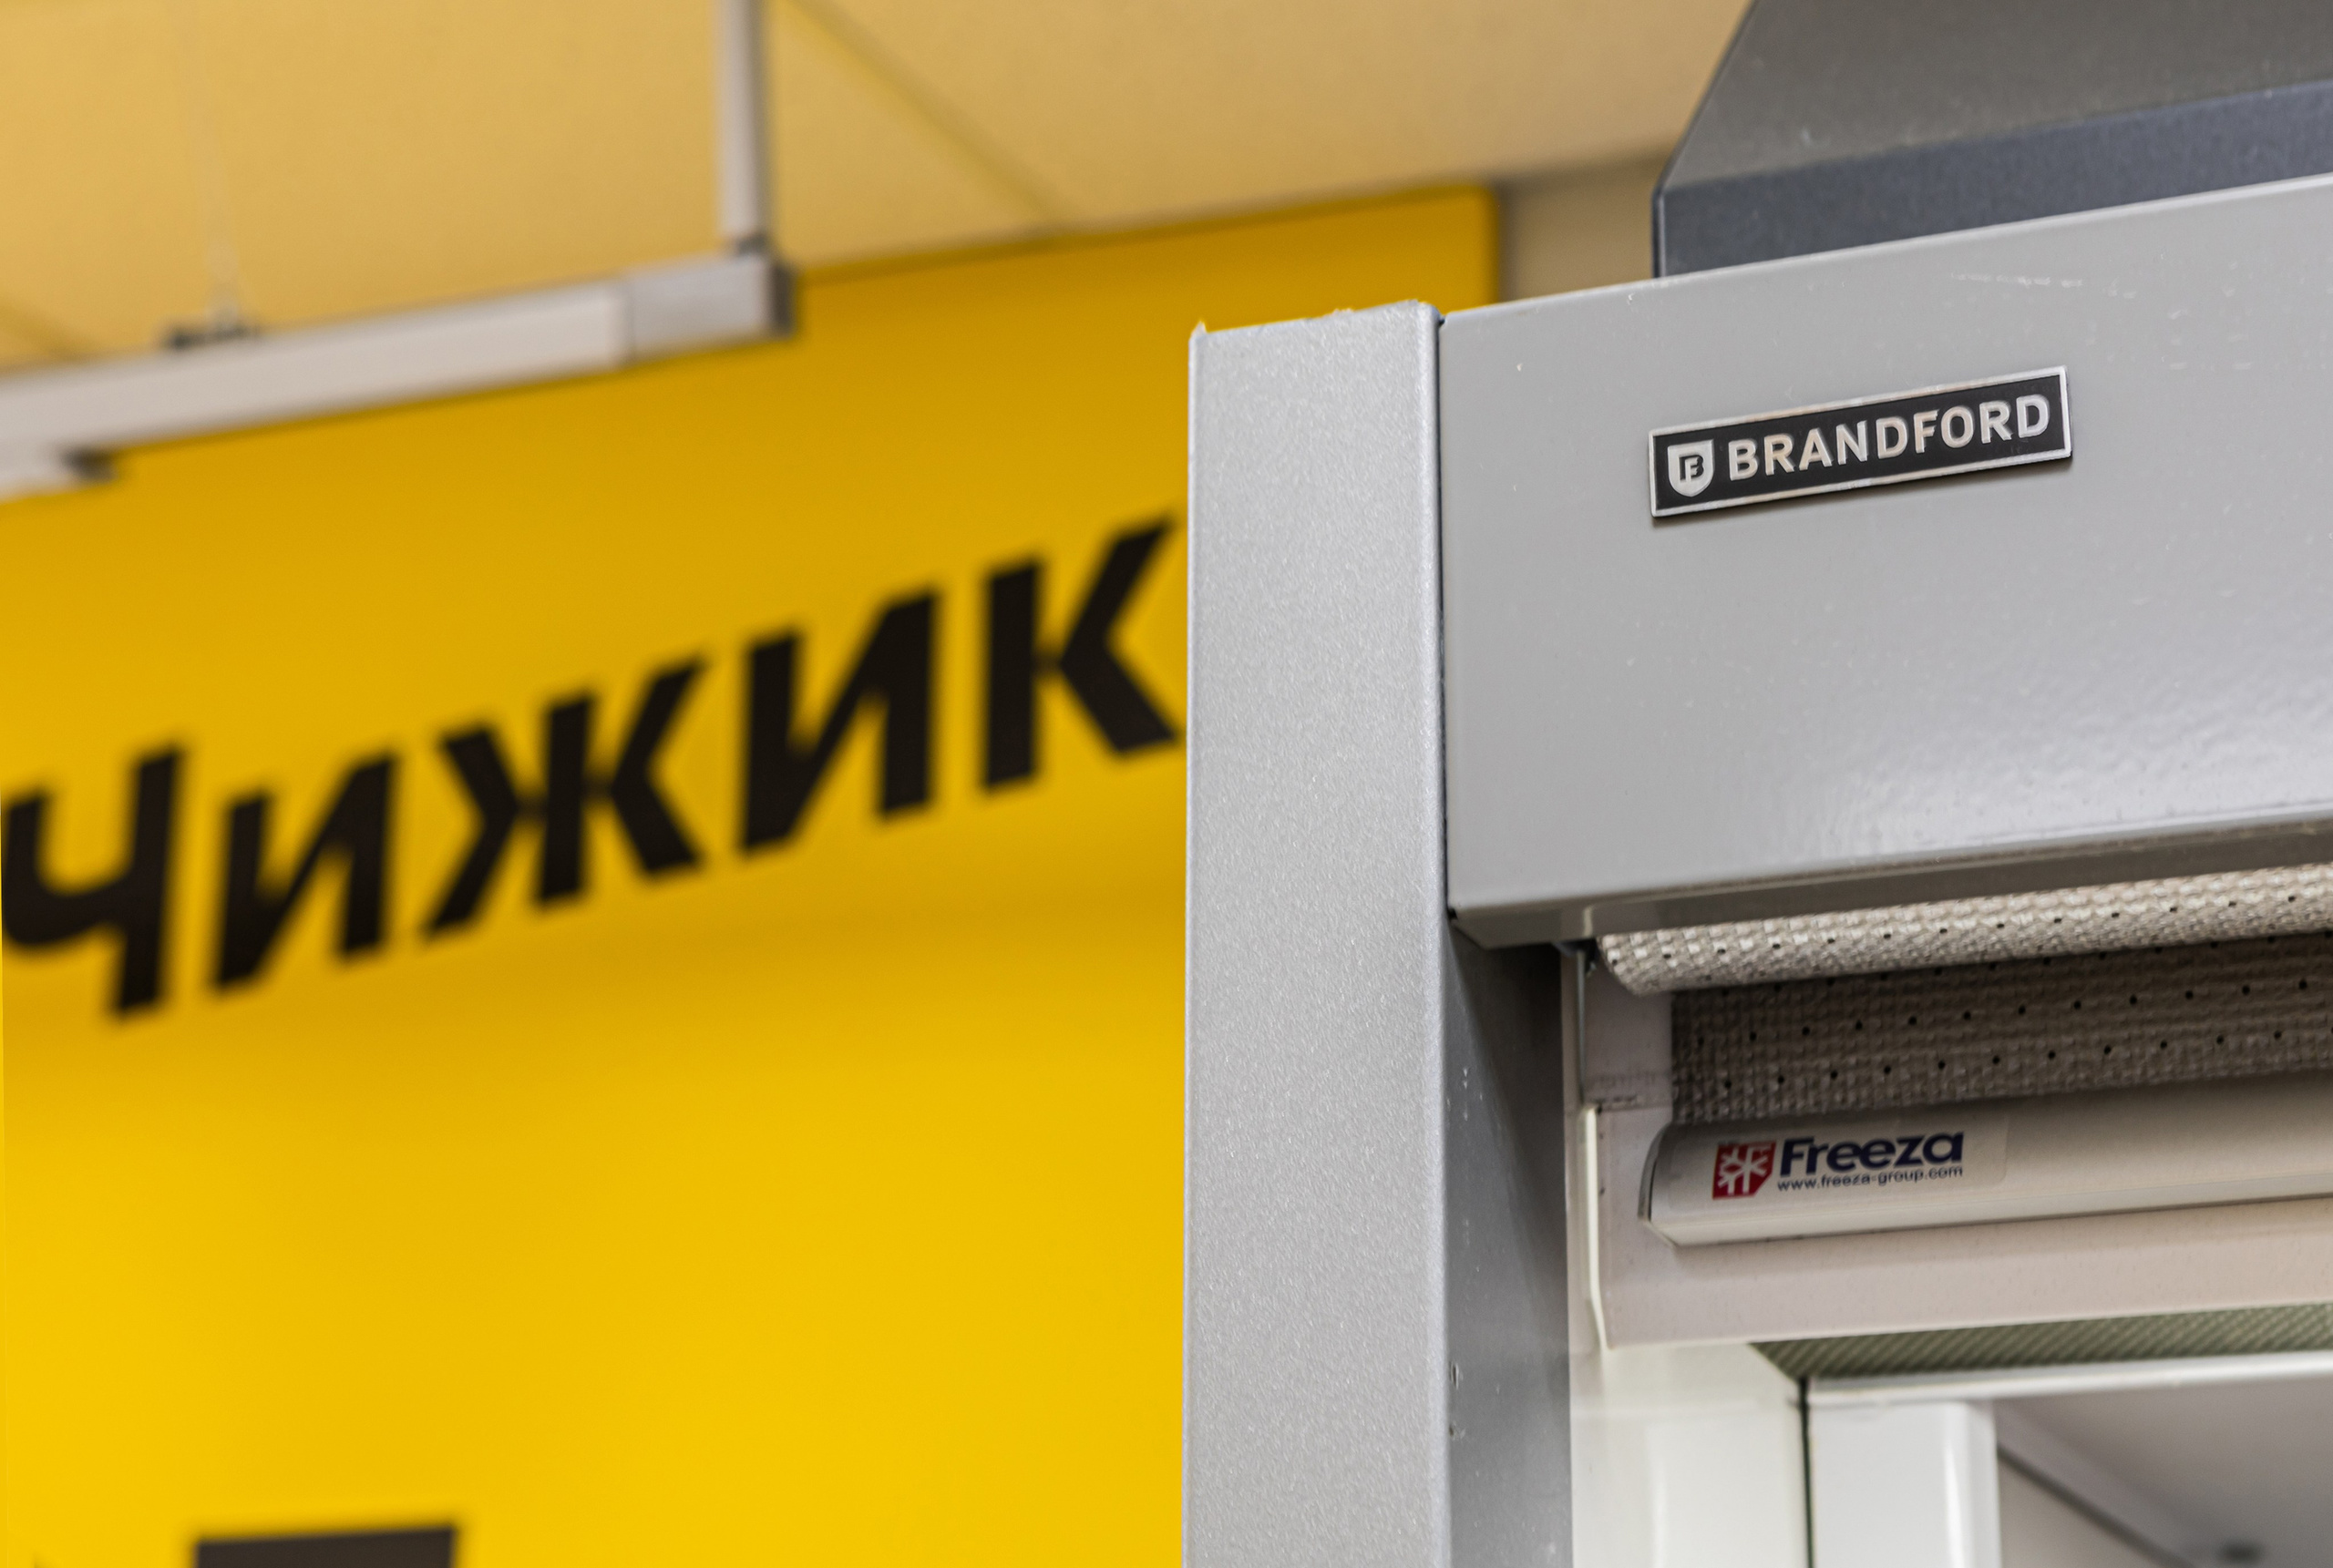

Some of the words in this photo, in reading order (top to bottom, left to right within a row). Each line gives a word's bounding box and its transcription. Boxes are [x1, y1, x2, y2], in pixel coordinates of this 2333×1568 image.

[1730, 395, 2050, 481] BRANDFORD
[1780, 1132, 1964, 1176] Freeza
[1777, 1167, 1963, 1192] www.freeza-group.com
